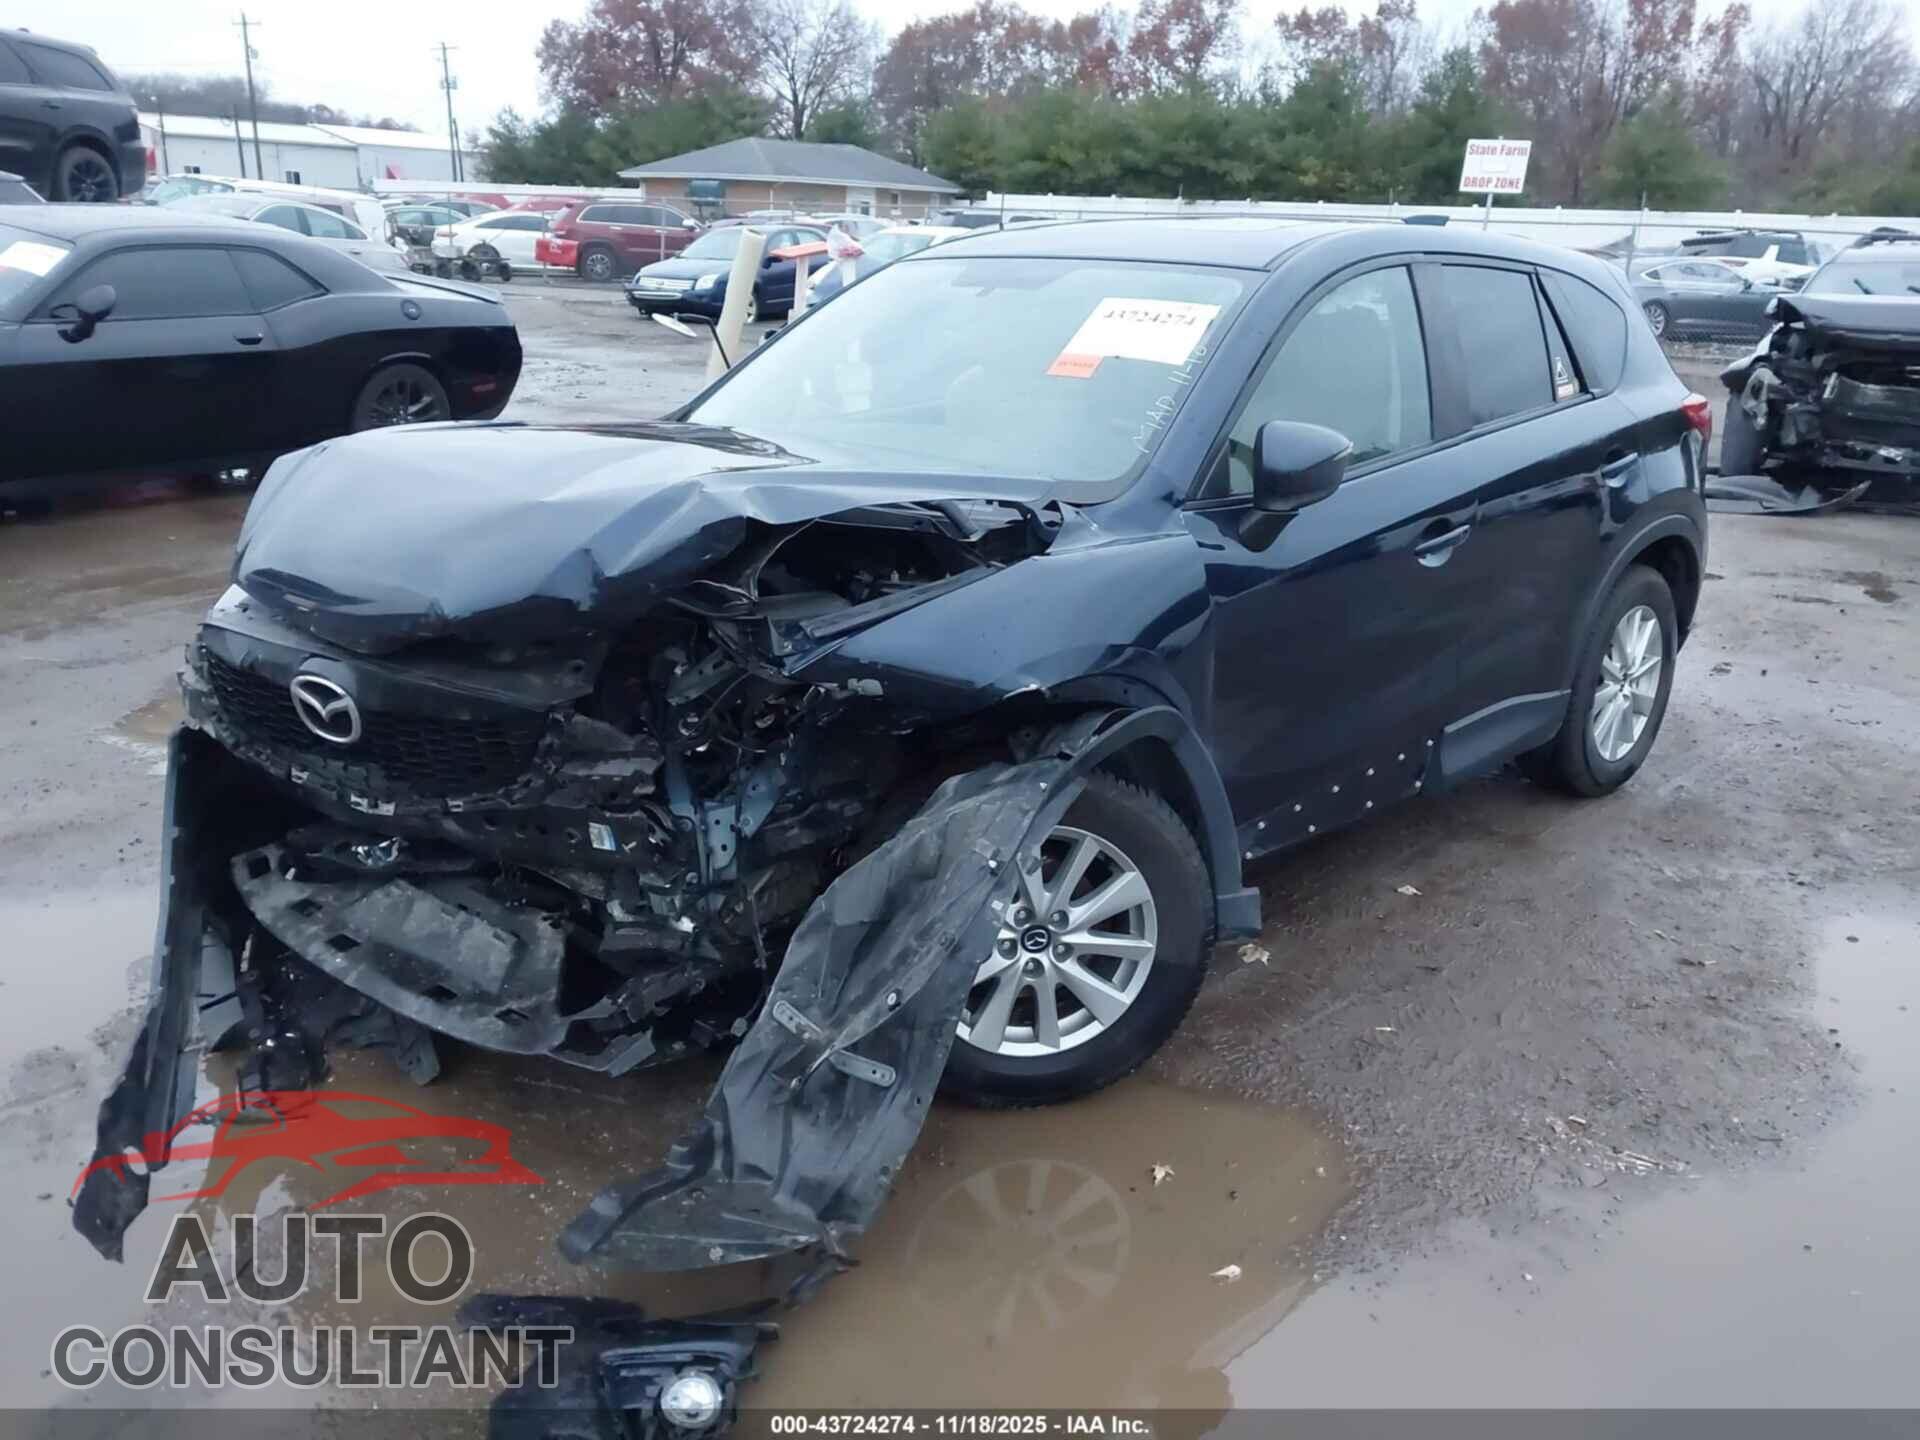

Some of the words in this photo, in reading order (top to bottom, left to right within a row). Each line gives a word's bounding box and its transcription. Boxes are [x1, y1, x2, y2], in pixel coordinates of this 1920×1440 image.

[1468, 144, 1497, 155] State
[1500, 145, 1529, 157] Farm
[1463, 176, 1493, 188] DROP
[1494, 177, 1521, 189] ZONE
